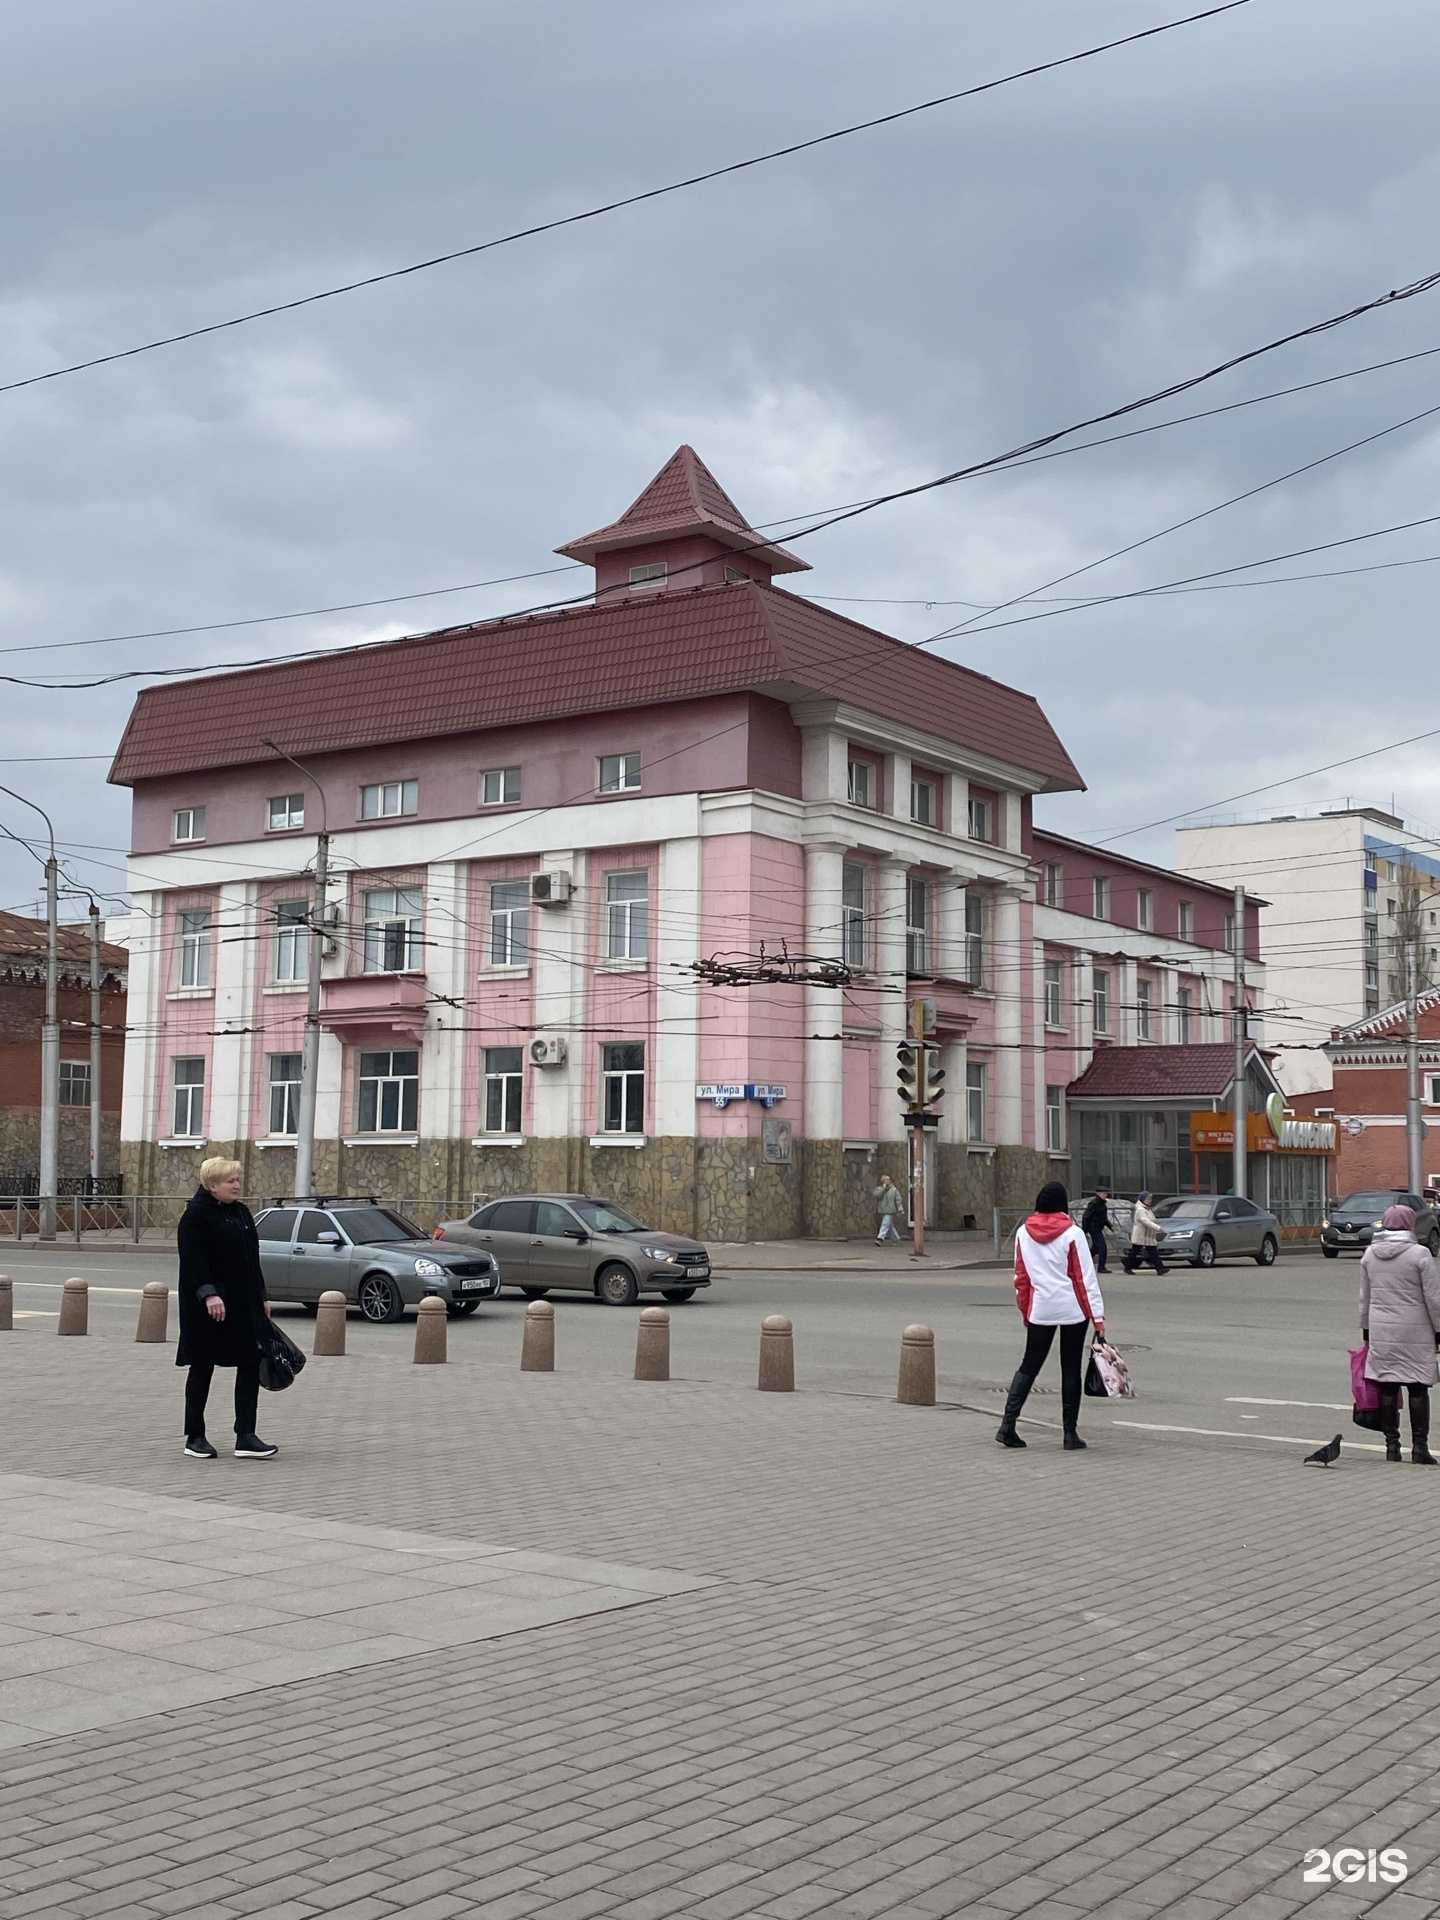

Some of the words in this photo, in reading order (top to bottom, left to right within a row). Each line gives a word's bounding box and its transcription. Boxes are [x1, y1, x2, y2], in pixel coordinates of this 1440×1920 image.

[701, 1087, 714, 1096] ул.
[716, 1086, 740, 1095] Мира
[768, 1086, 784, 1096] Мира
[715, 1097, 725, 1106] 55
